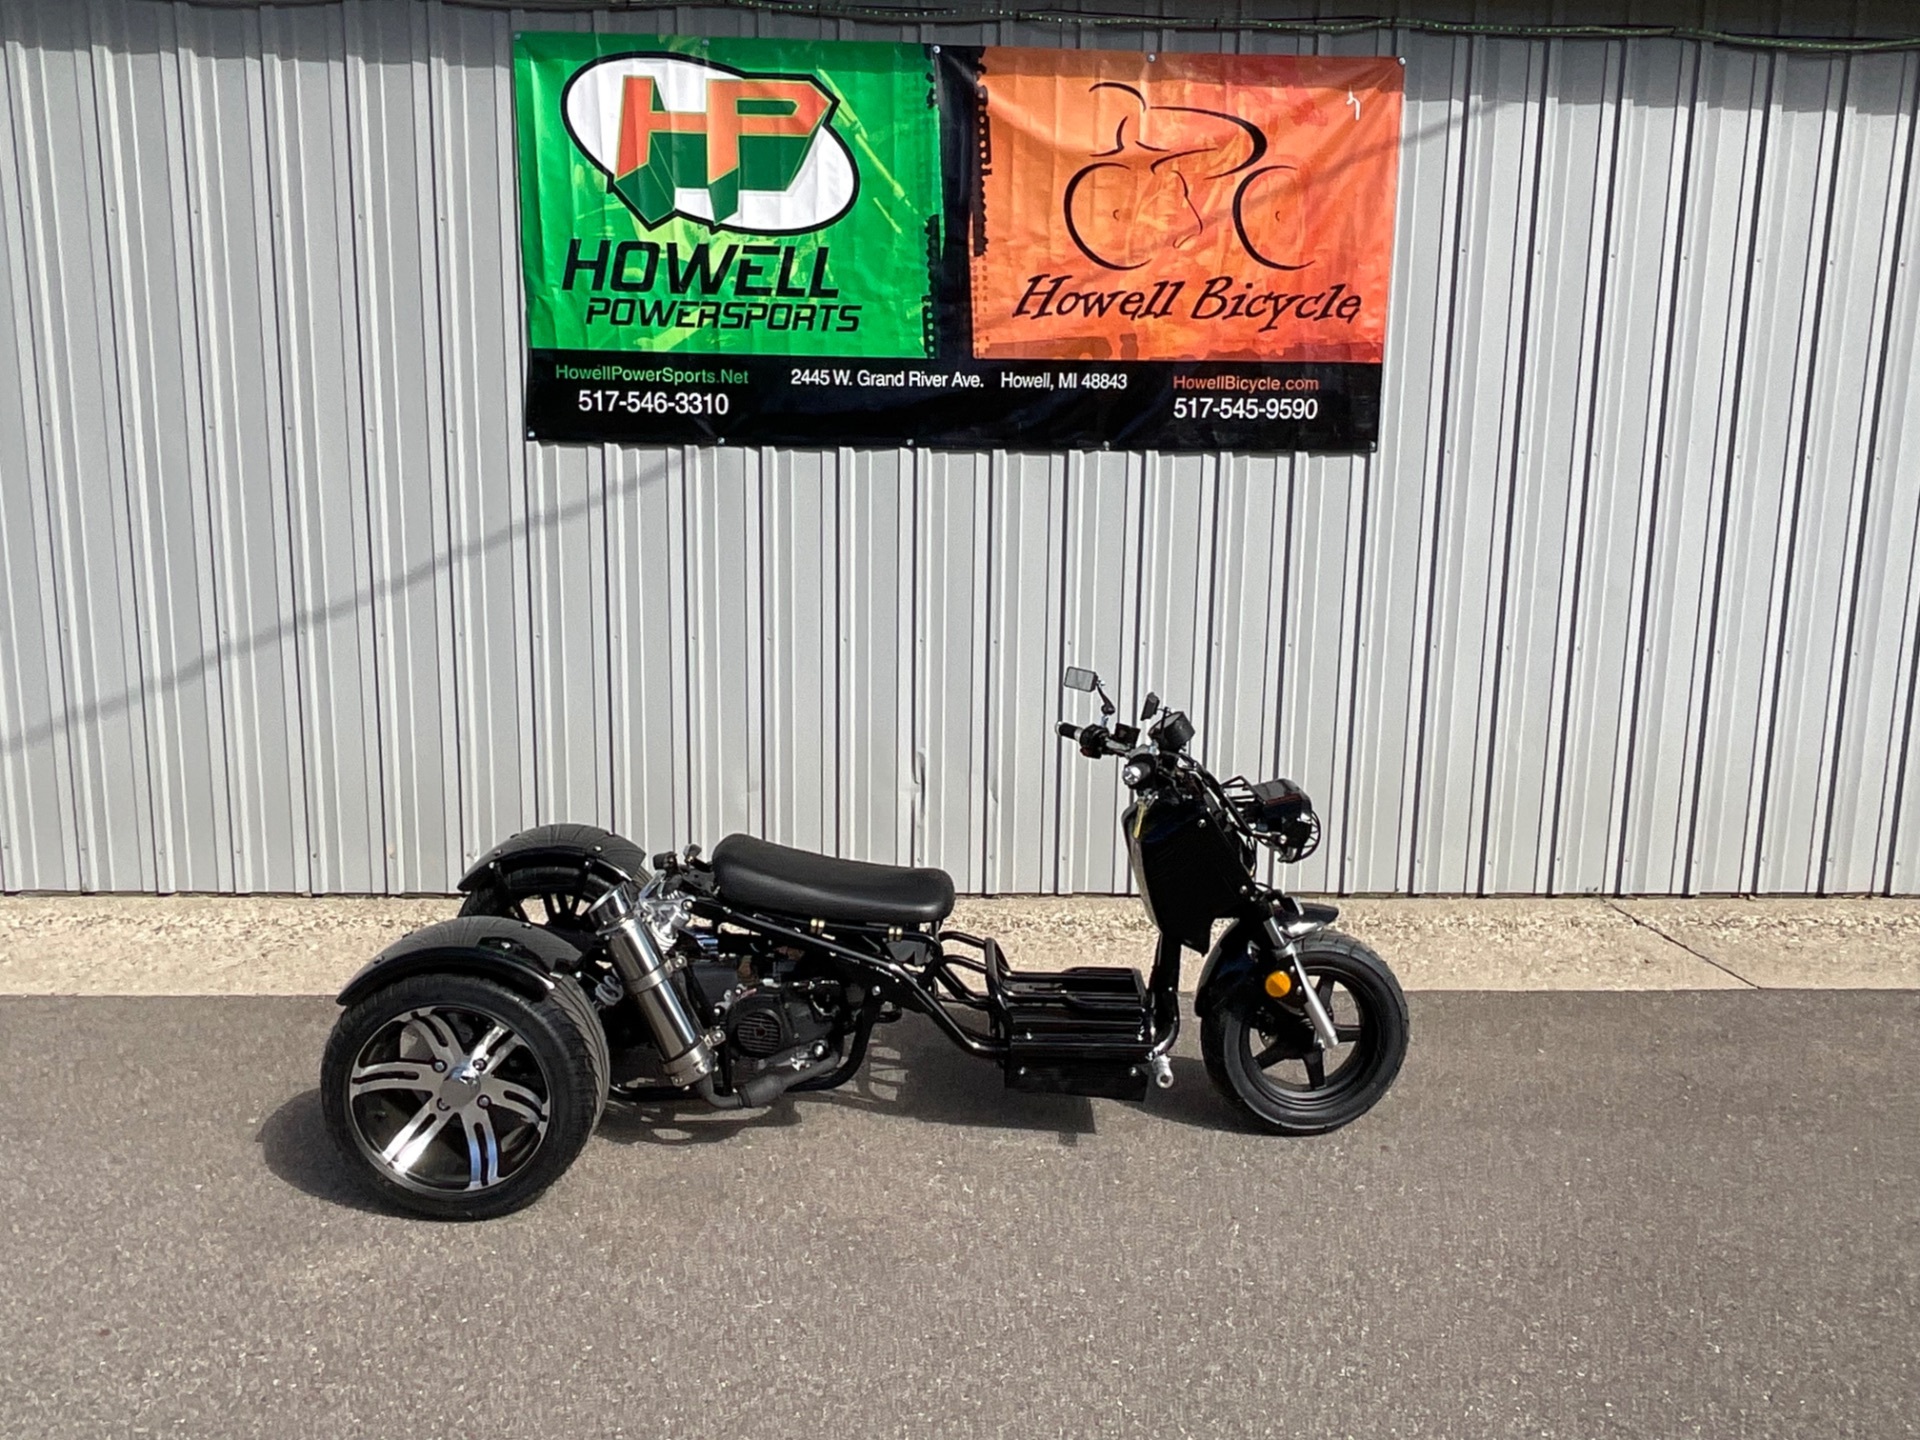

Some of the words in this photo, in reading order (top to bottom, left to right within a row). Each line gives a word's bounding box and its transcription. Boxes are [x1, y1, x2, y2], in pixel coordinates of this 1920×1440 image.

[562, 238, 839, 298] HOWELL
[1012, 274, 1185, 320] Howell
[1190, 276, 1362, 332] Bicycle
[586, 298, 862, 332] POWERSPORTS
[555, 365, 749, 385] HowellPowerSports.Net
[790, 368, 830, 386] 2445
[833, 369, 853, 387] W.
[856, 371, 905, 388] Grand
[908, 371, 948, 388] River
[950, 371, 985, 390] Ave.
[1000, 371, 1054, 393] Howell,
[1058, 373, 1078, 390] MI
[1080, 373, 1128, 391] 48843
[1172, 375, 1320, 393] HowellBicycle.com
[578, 390, 729, 415] 517-546-3310
[1173, 398, 1318, 420] 517-545-9590
